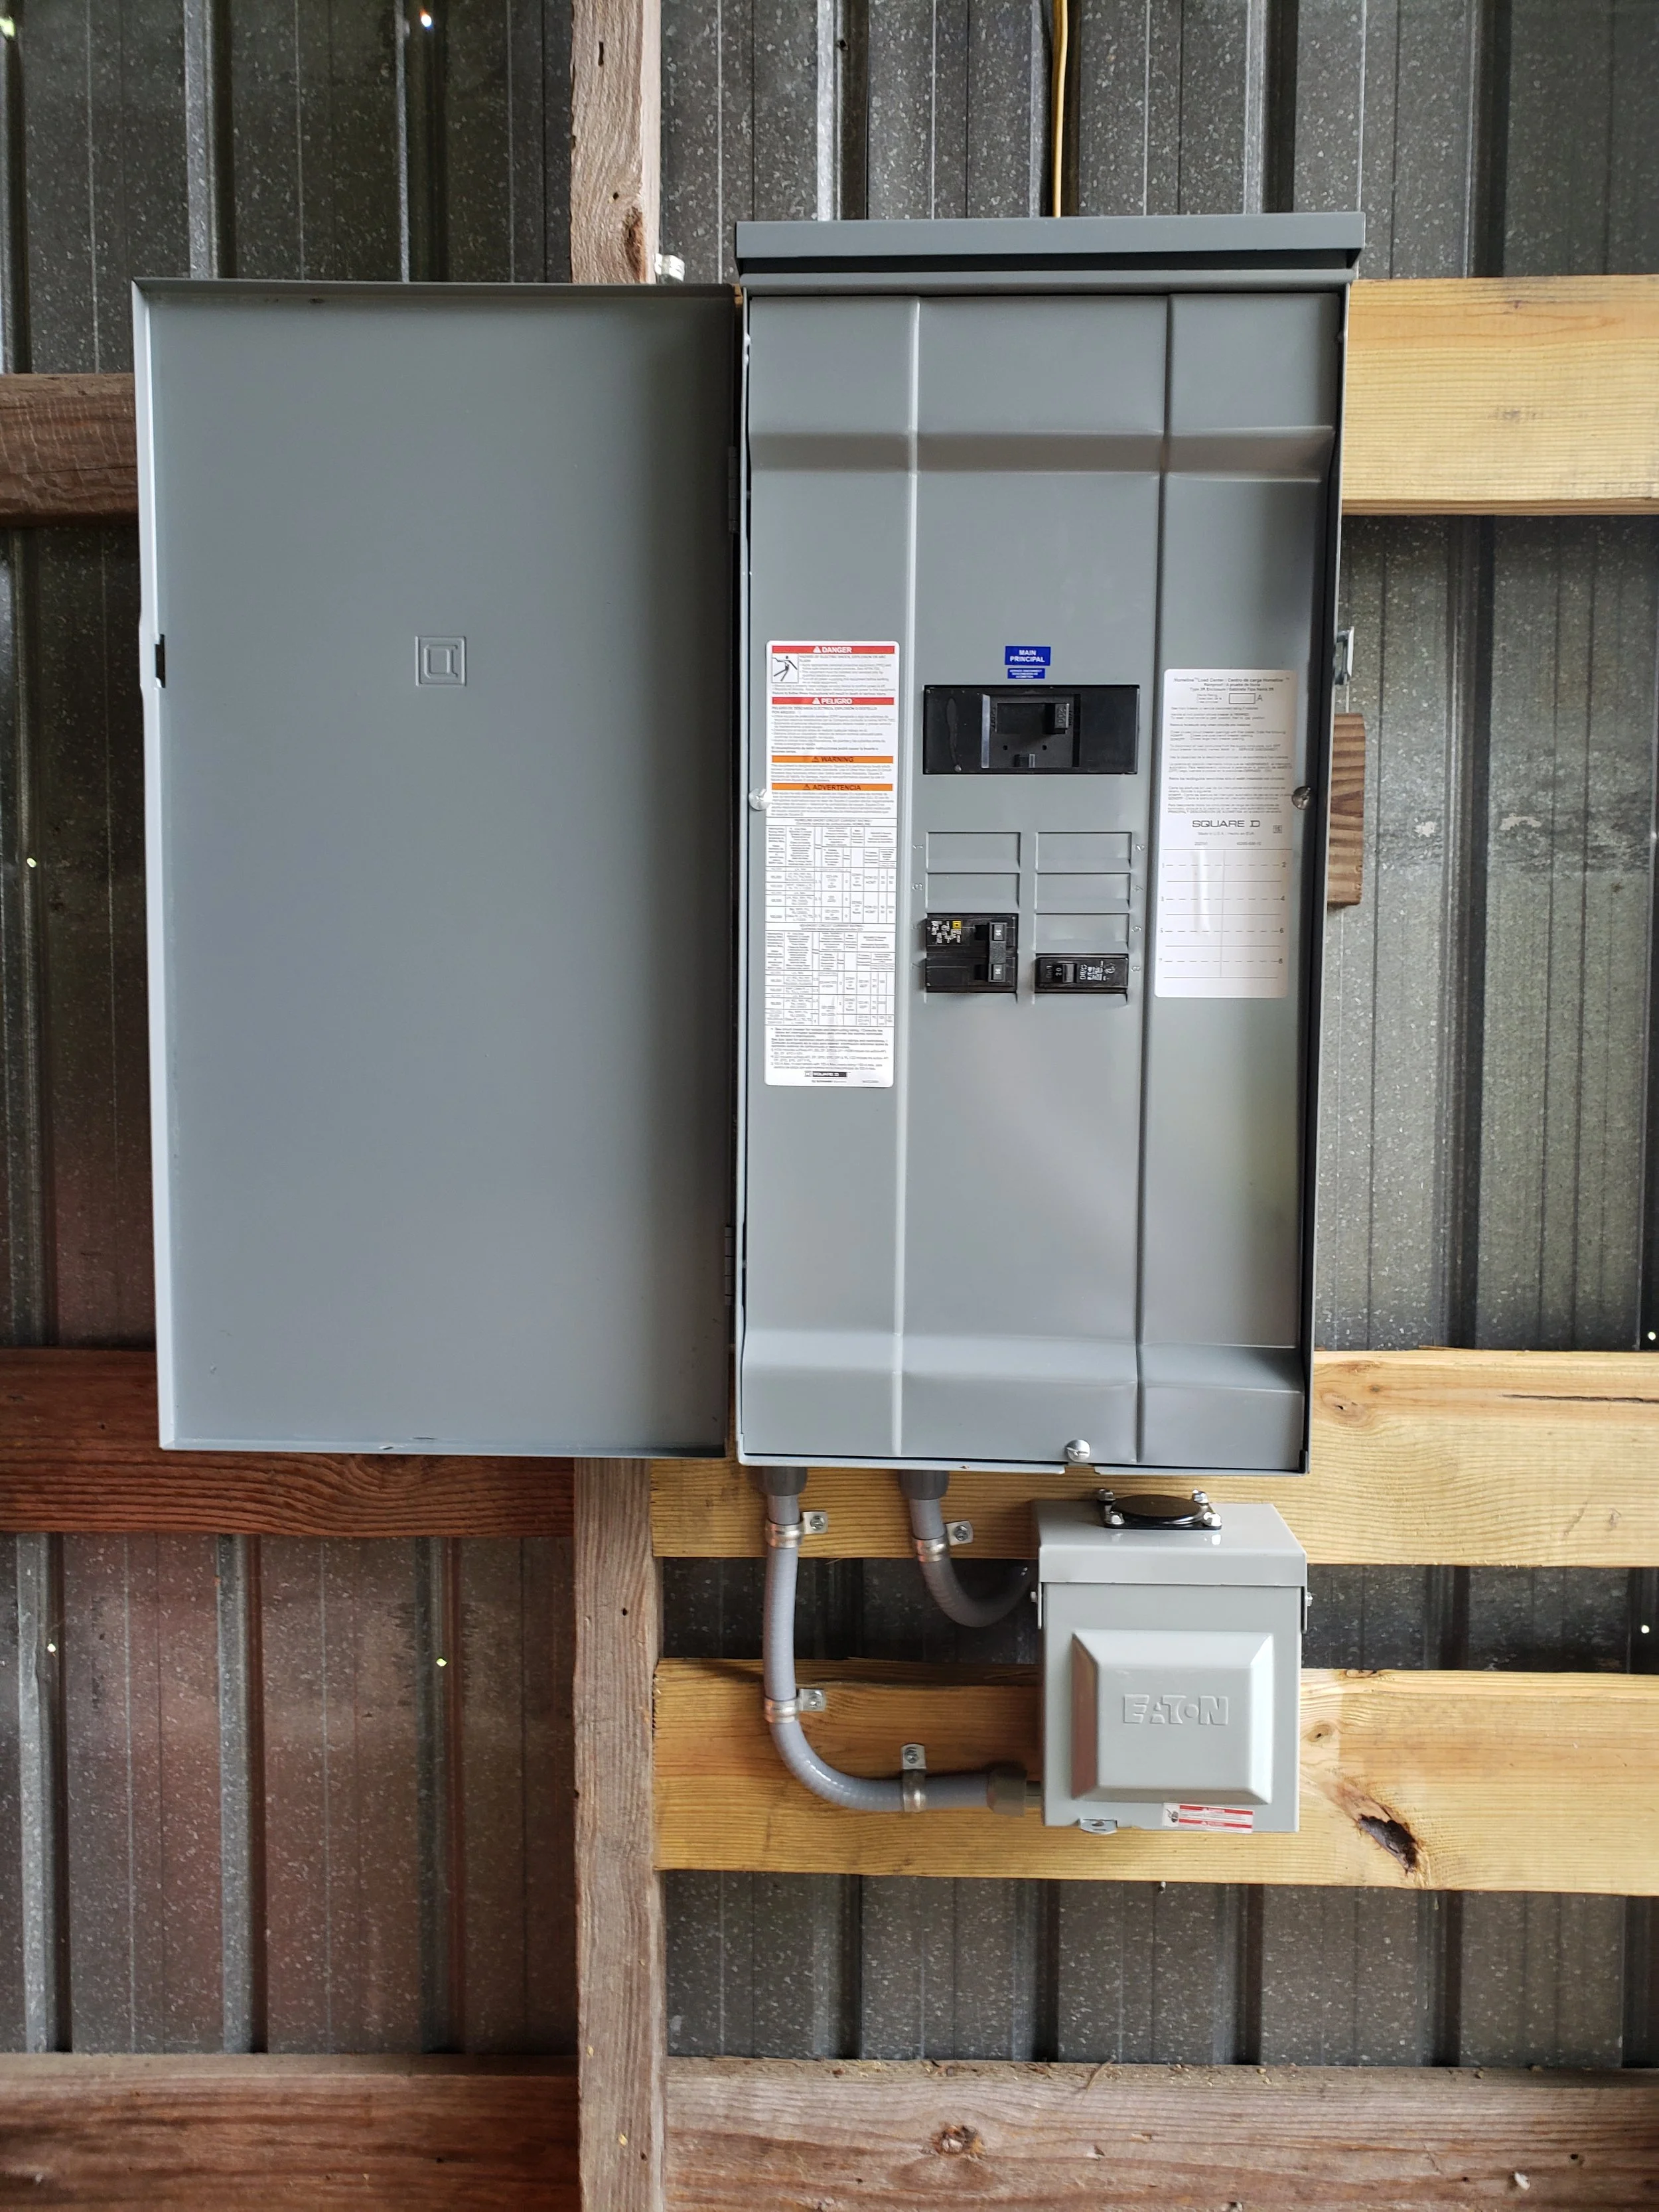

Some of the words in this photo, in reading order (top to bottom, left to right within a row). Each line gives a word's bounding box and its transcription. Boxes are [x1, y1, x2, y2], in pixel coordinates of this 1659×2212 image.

[1056, 705, 1066, 724] 200
[1056, 968, 1062, 976] 20
[1123, 1694, 1228, 1726] EATON
